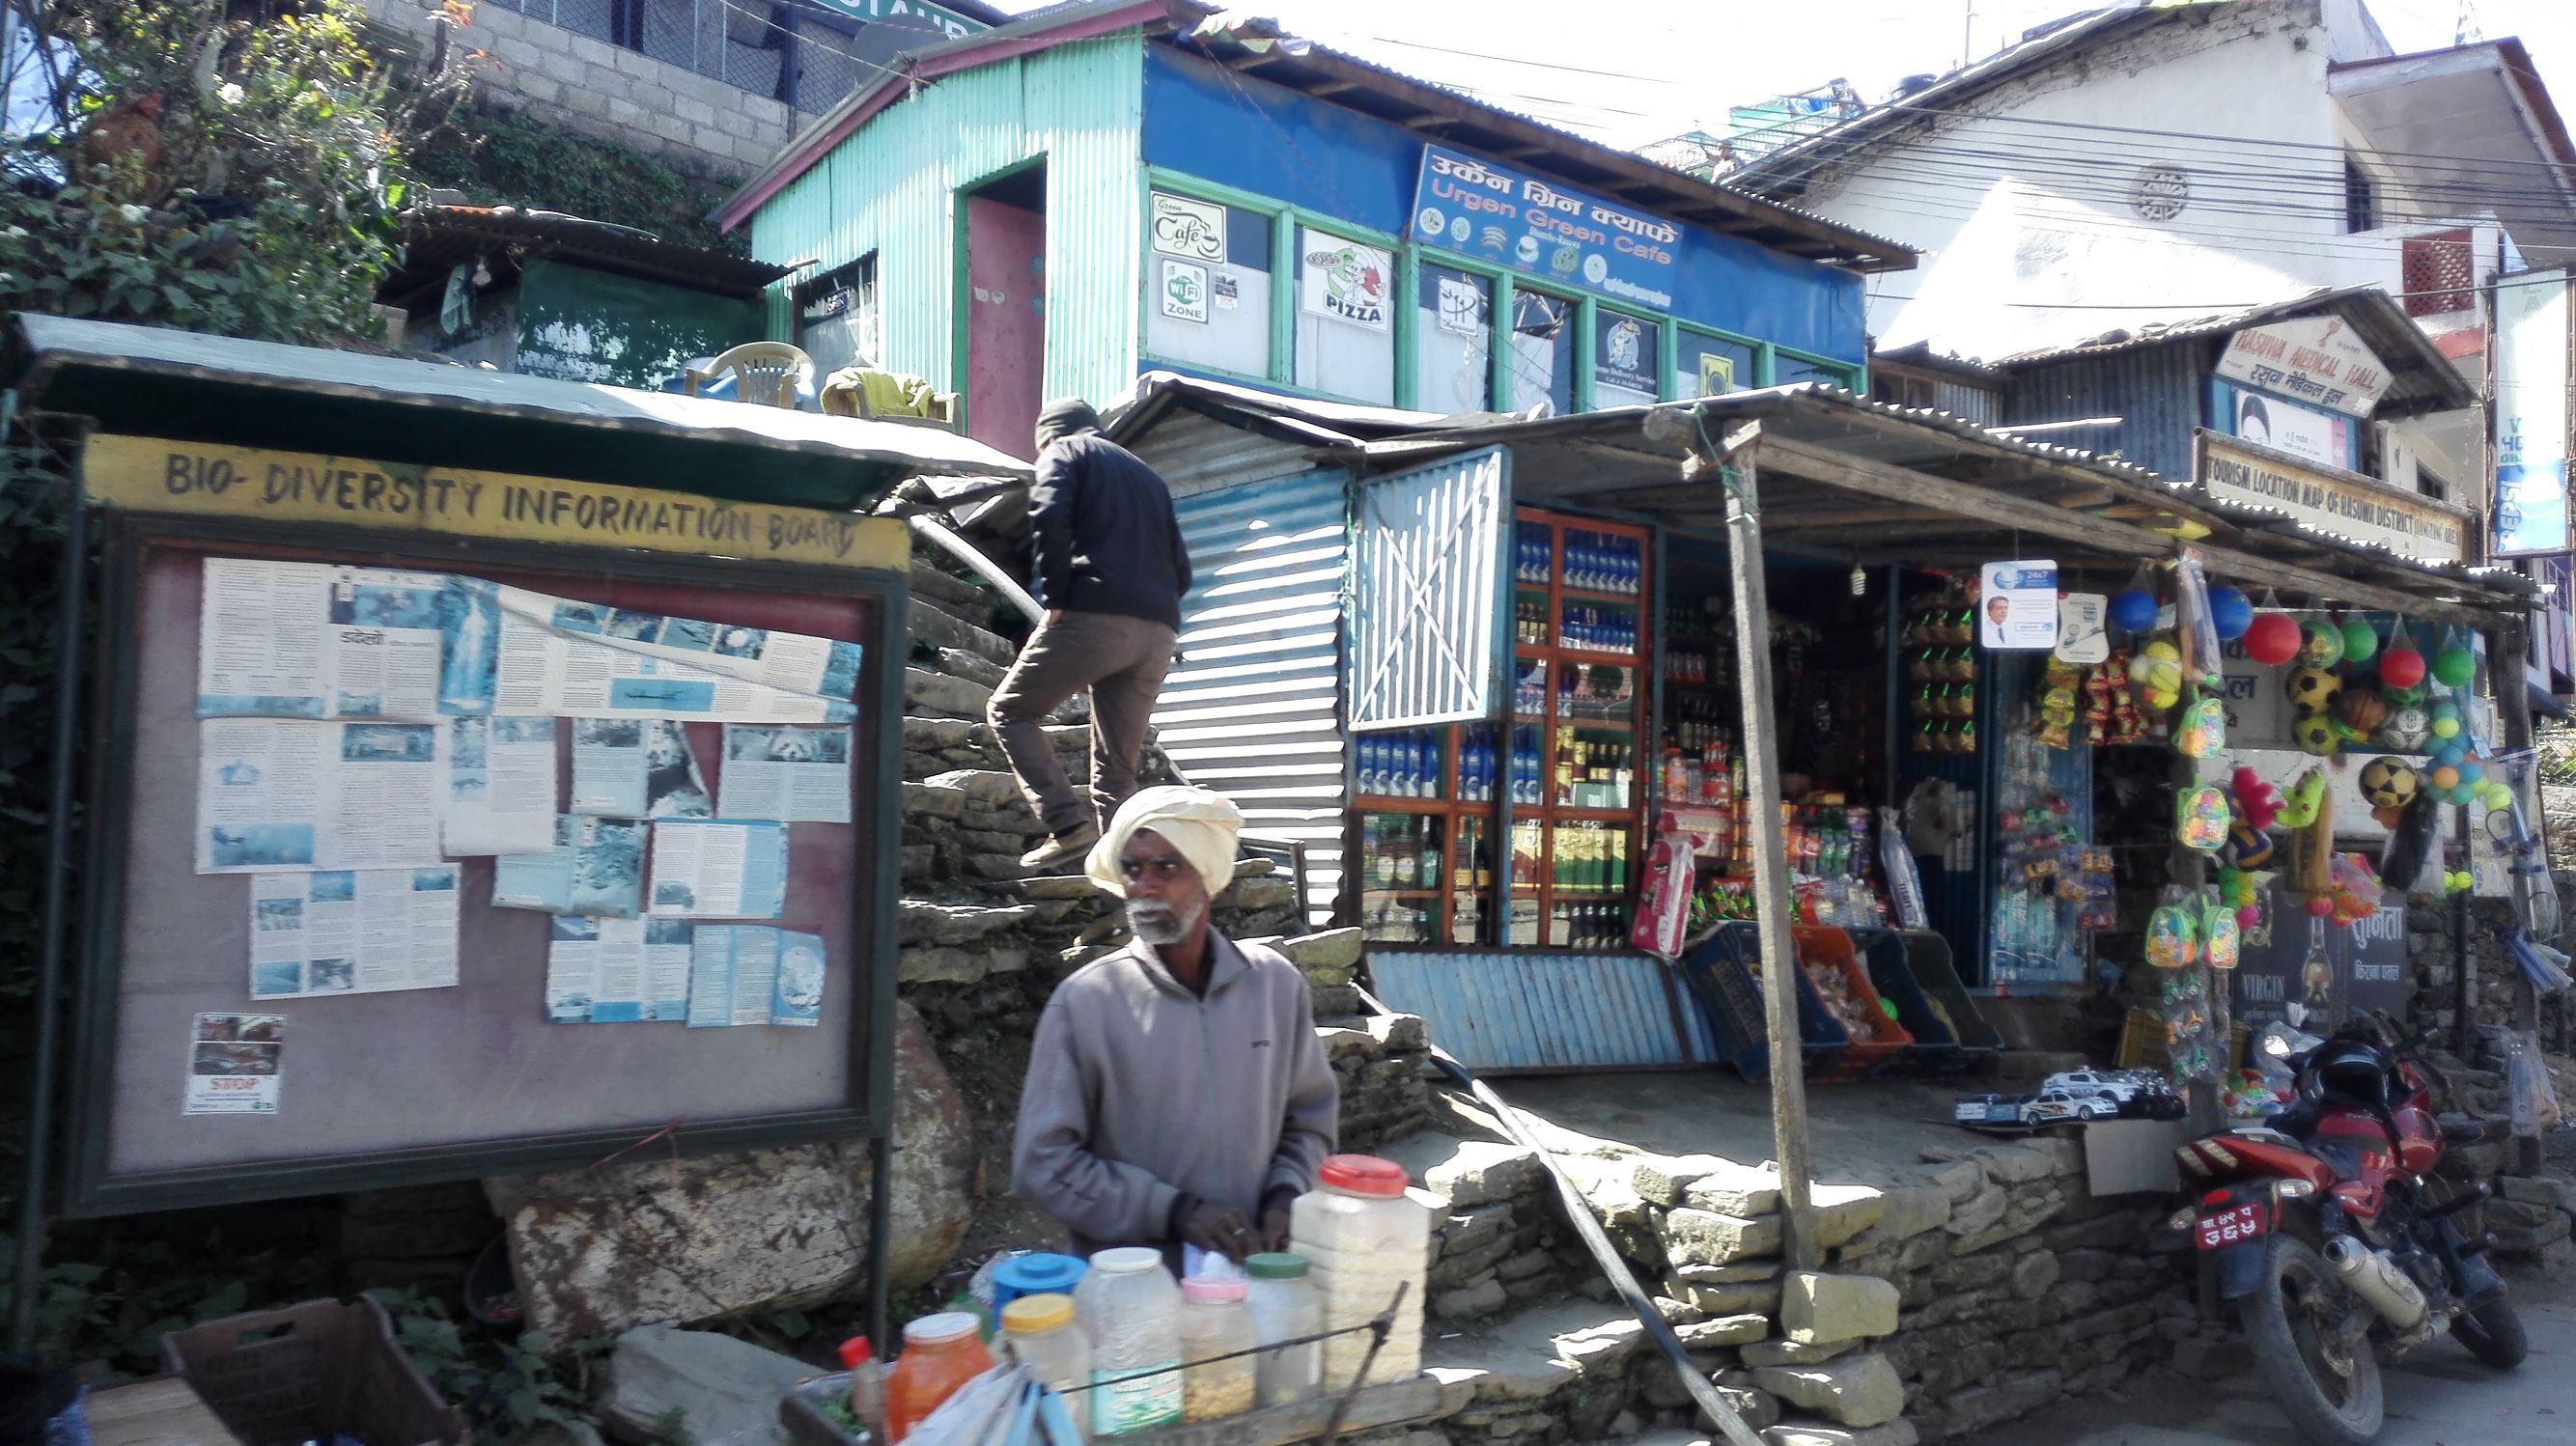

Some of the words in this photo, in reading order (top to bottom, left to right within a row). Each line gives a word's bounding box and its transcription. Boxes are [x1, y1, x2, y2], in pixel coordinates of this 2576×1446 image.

[1431, 179, 1516, 218] Urgen
[1525, 208, 1606, 246] Green
[1613, 235, 1672, 265] Cafe
[1326, 292, 1382, 321] PIZZA
[2233, 328, 2287, 361] RASUWA
[2288, 346, 2340, 378] MEDICAL
[2342, 363, 2379, 390] HALL
[261, 463, 484, 518] DIVERSITY
[501, 486, 752, 542] INFORMATION
[768, 513, 854, 558] BOARD
[2208, 456, 2251, 490] TOURISM
[2253, 468, 2300, 505] LOCATION
[2303, 482, 2324, 509] MAP
[2327, 490, 2340, 514] OF
[2341, 493, 2375, 525] RASUWA
[2376, 506, 2413, 535] DISTRICT
[2242, 974, 2285, 1001] VIRGIN
[210, 1077, 260, 1091] STOP
